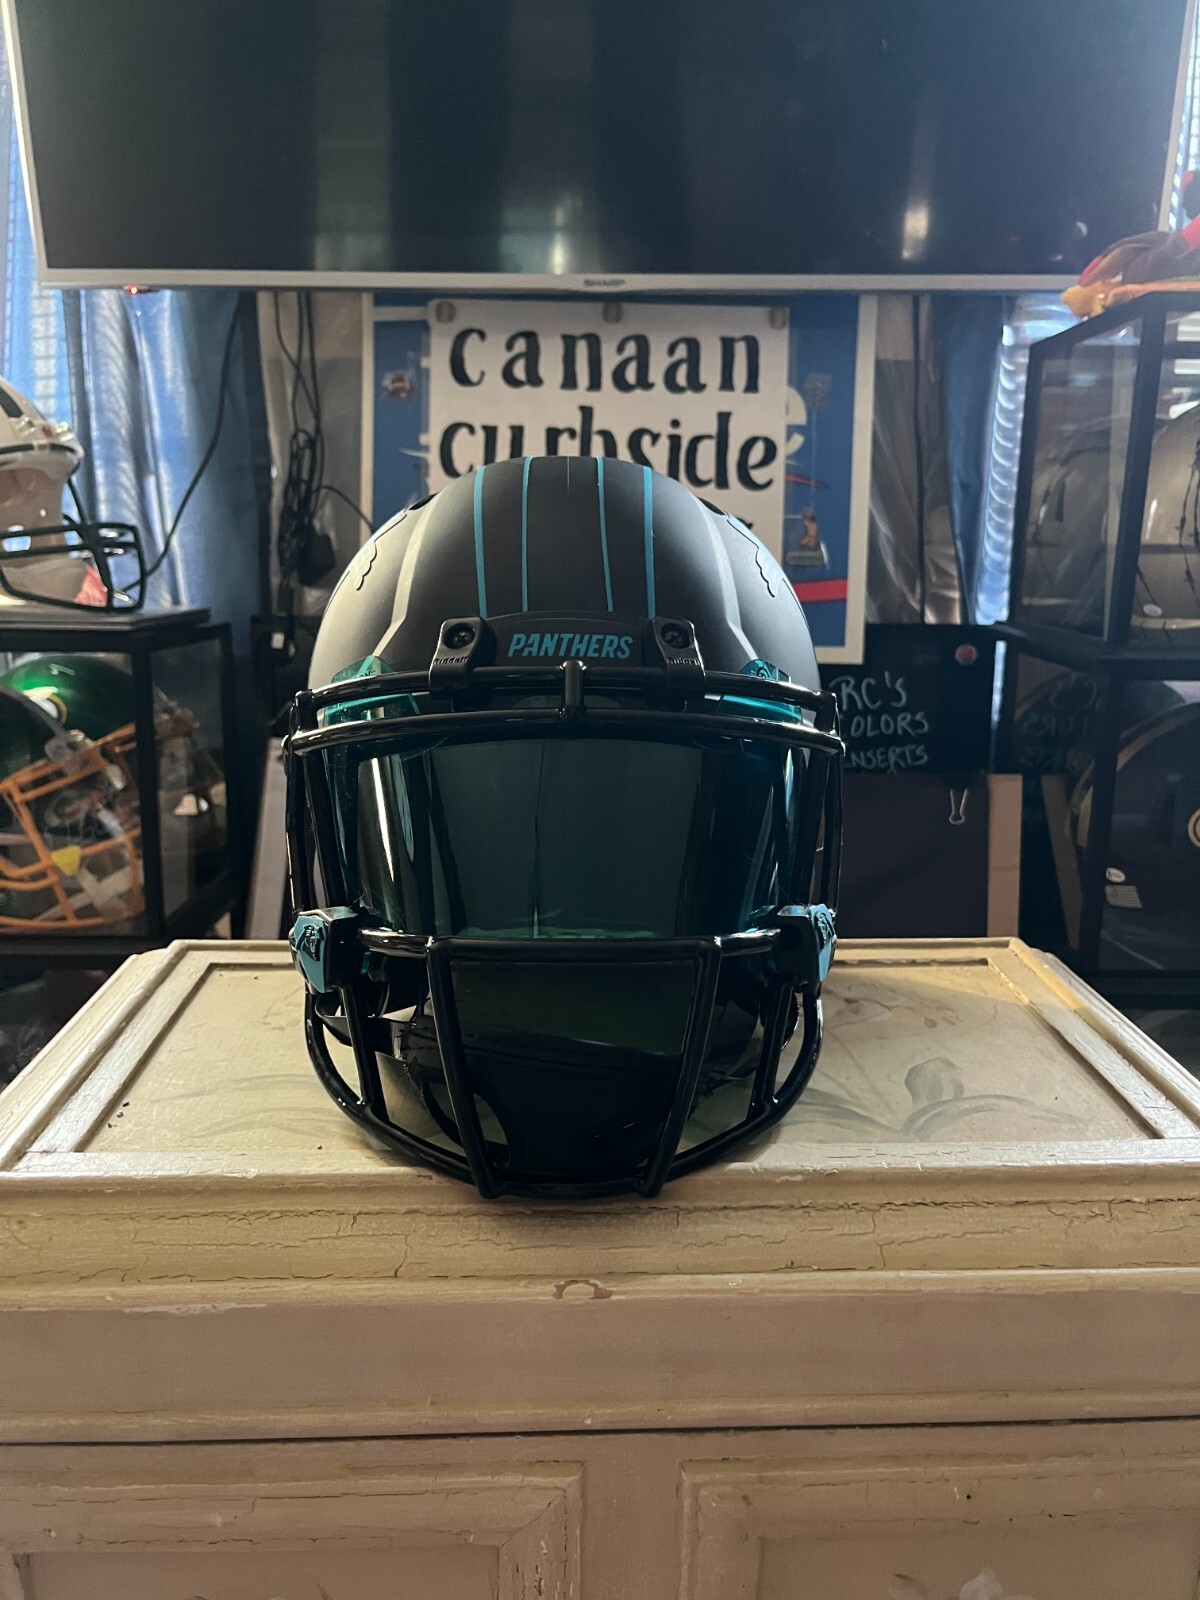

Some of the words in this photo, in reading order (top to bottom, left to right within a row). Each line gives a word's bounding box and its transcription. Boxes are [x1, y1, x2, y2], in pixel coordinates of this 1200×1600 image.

[449, 328, 760, 394] canaan
[507, 633, 633, 660] PANTHERS
[840, 711, 929, 738] OLORS
